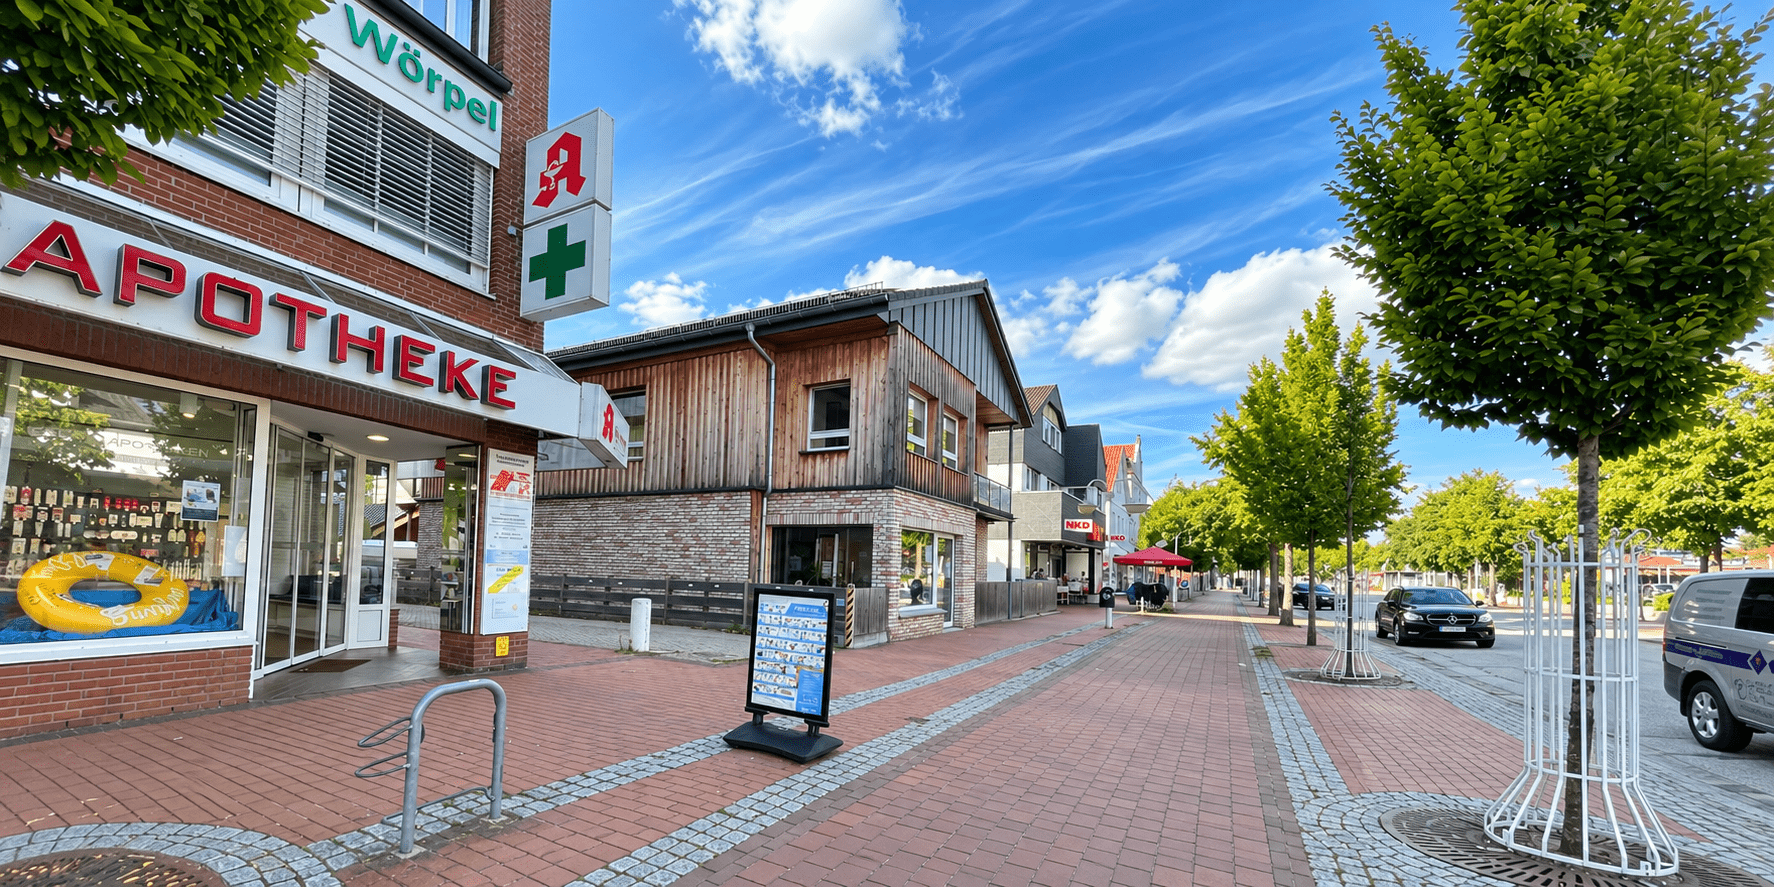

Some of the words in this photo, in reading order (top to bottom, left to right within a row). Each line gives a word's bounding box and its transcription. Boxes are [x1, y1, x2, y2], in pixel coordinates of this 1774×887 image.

[344, 3, 497, 131] Wörpel
[1, 220, 516, 410] APOTHEKE
[1066, 521, 1090, 529] NKD
